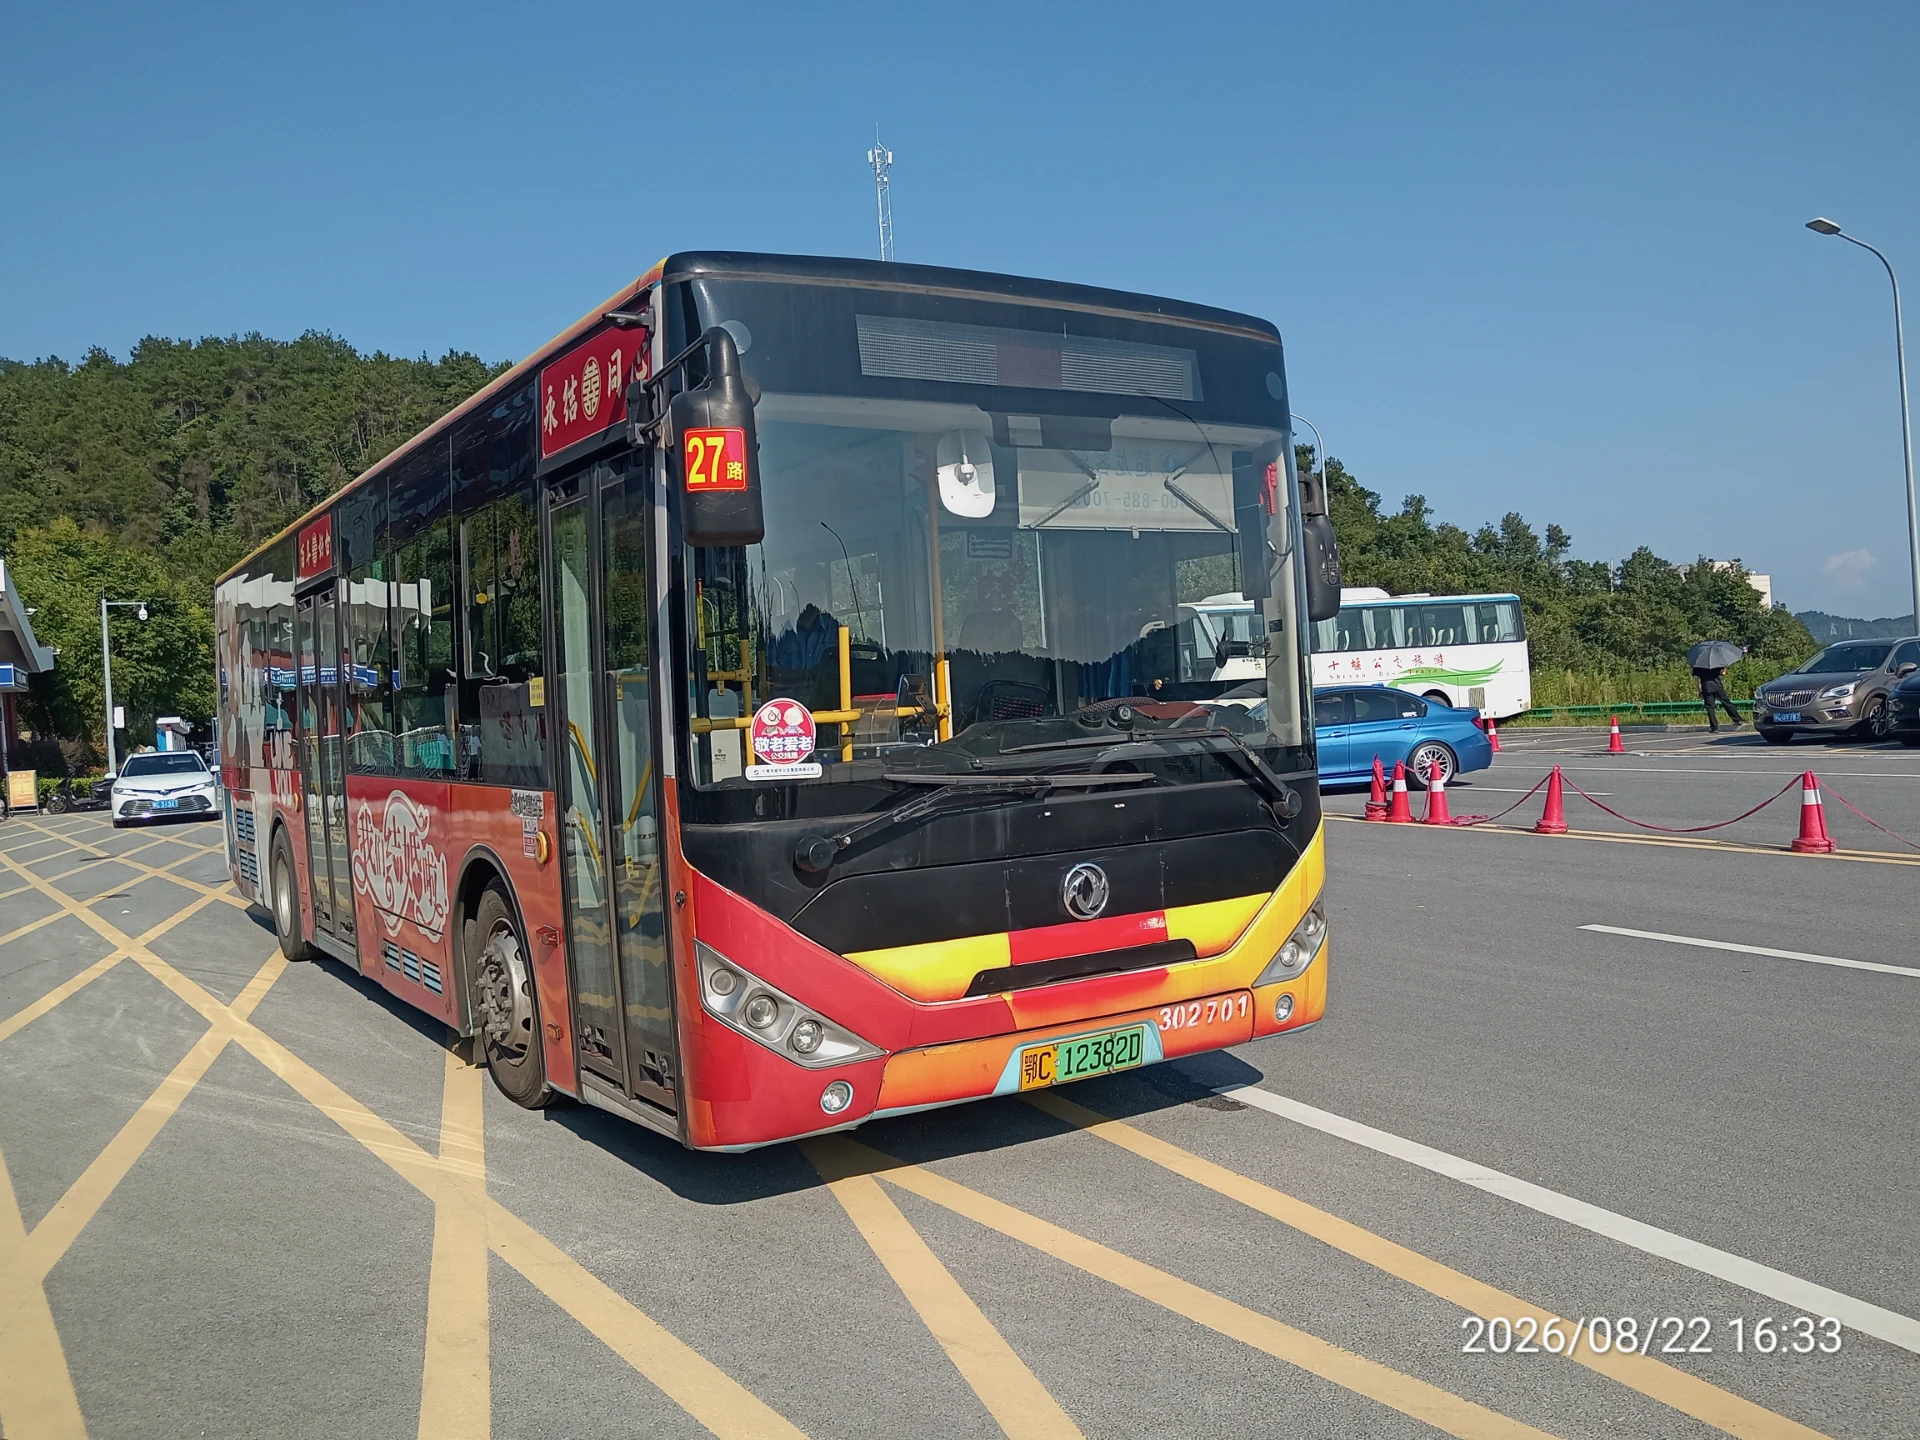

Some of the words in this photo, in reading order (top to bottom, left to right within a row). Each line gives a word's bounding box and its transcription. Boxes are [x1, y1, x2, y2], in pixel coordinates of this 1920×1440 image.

[1328, 652, 1444, 671] 十堰公交旅游
[754, 735, 812, 752] 敬老爱老
[1159, 994, 1249, 1031] 302701
